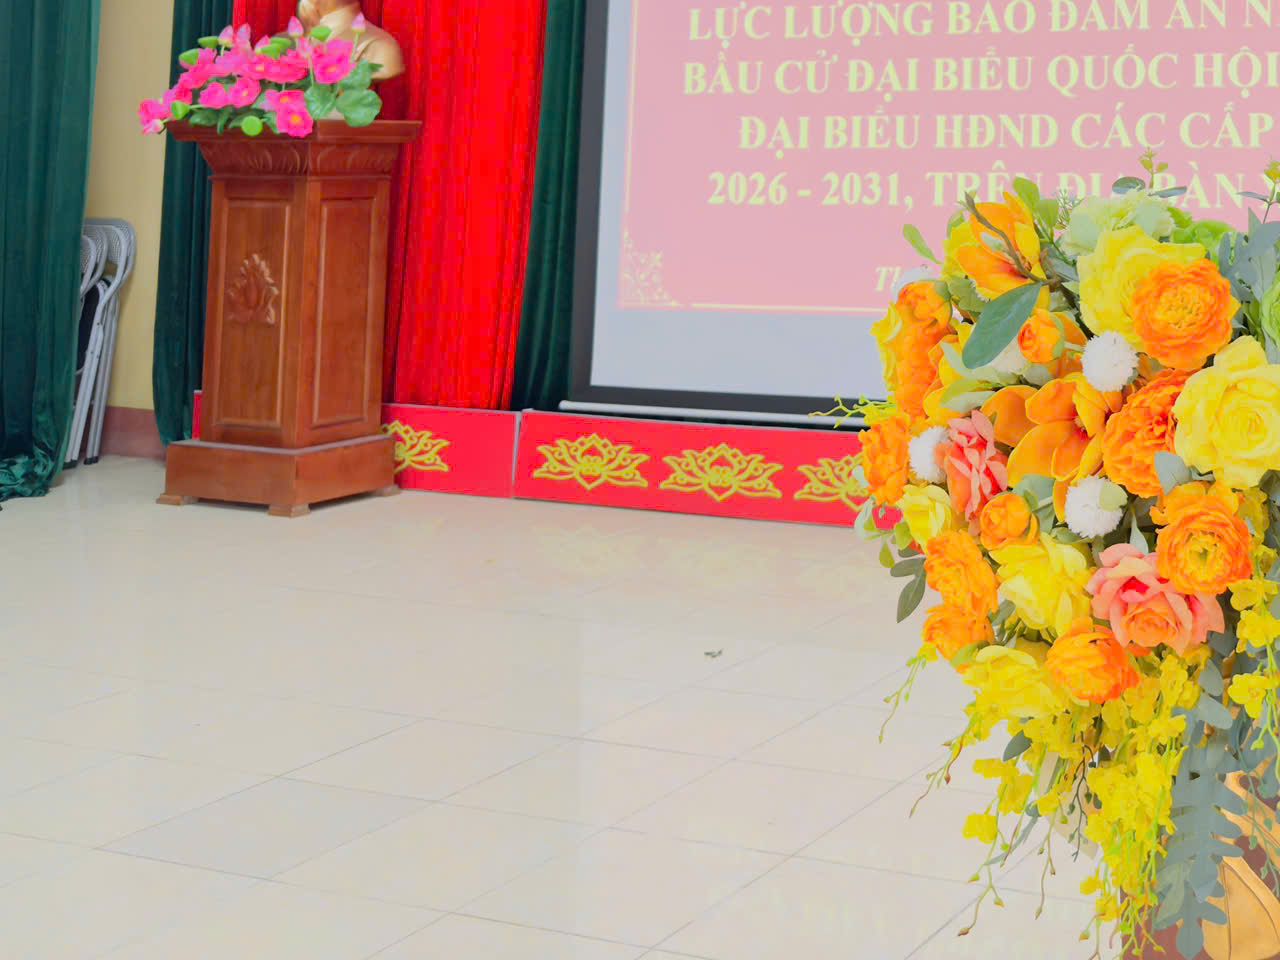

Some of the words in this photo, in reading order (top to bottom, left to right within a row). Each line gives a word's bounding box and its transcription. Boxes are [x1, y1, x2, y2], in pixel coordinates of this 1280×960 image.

[689, 1, 771, 49] LỰC
[783, 0, 934, 47] LƯỢNG
[683, 51, 764, 95] BẦU
[775, 47, 839, 94] CỬ
[845, 58, 920, 103] ĐẠI
[932, 46, 1033, 92] BIỂU
[1047, 45, 1177, 97] QUỐC
[1192, 45, 1280, 100] HỘI
[739, 116, 809, 160] ĐẠI
[823, 106, 921, 150] BIỂU
[935, 114, 1059, 150] HĐND
[1071, 102, 1167, 150] CÁC
[1179, 103, 1273, 150] CẤP
[708, 171, 788, 206] 2026
[796, 189, 813, 198] -
[821, 171, 914, 213] 2031,
